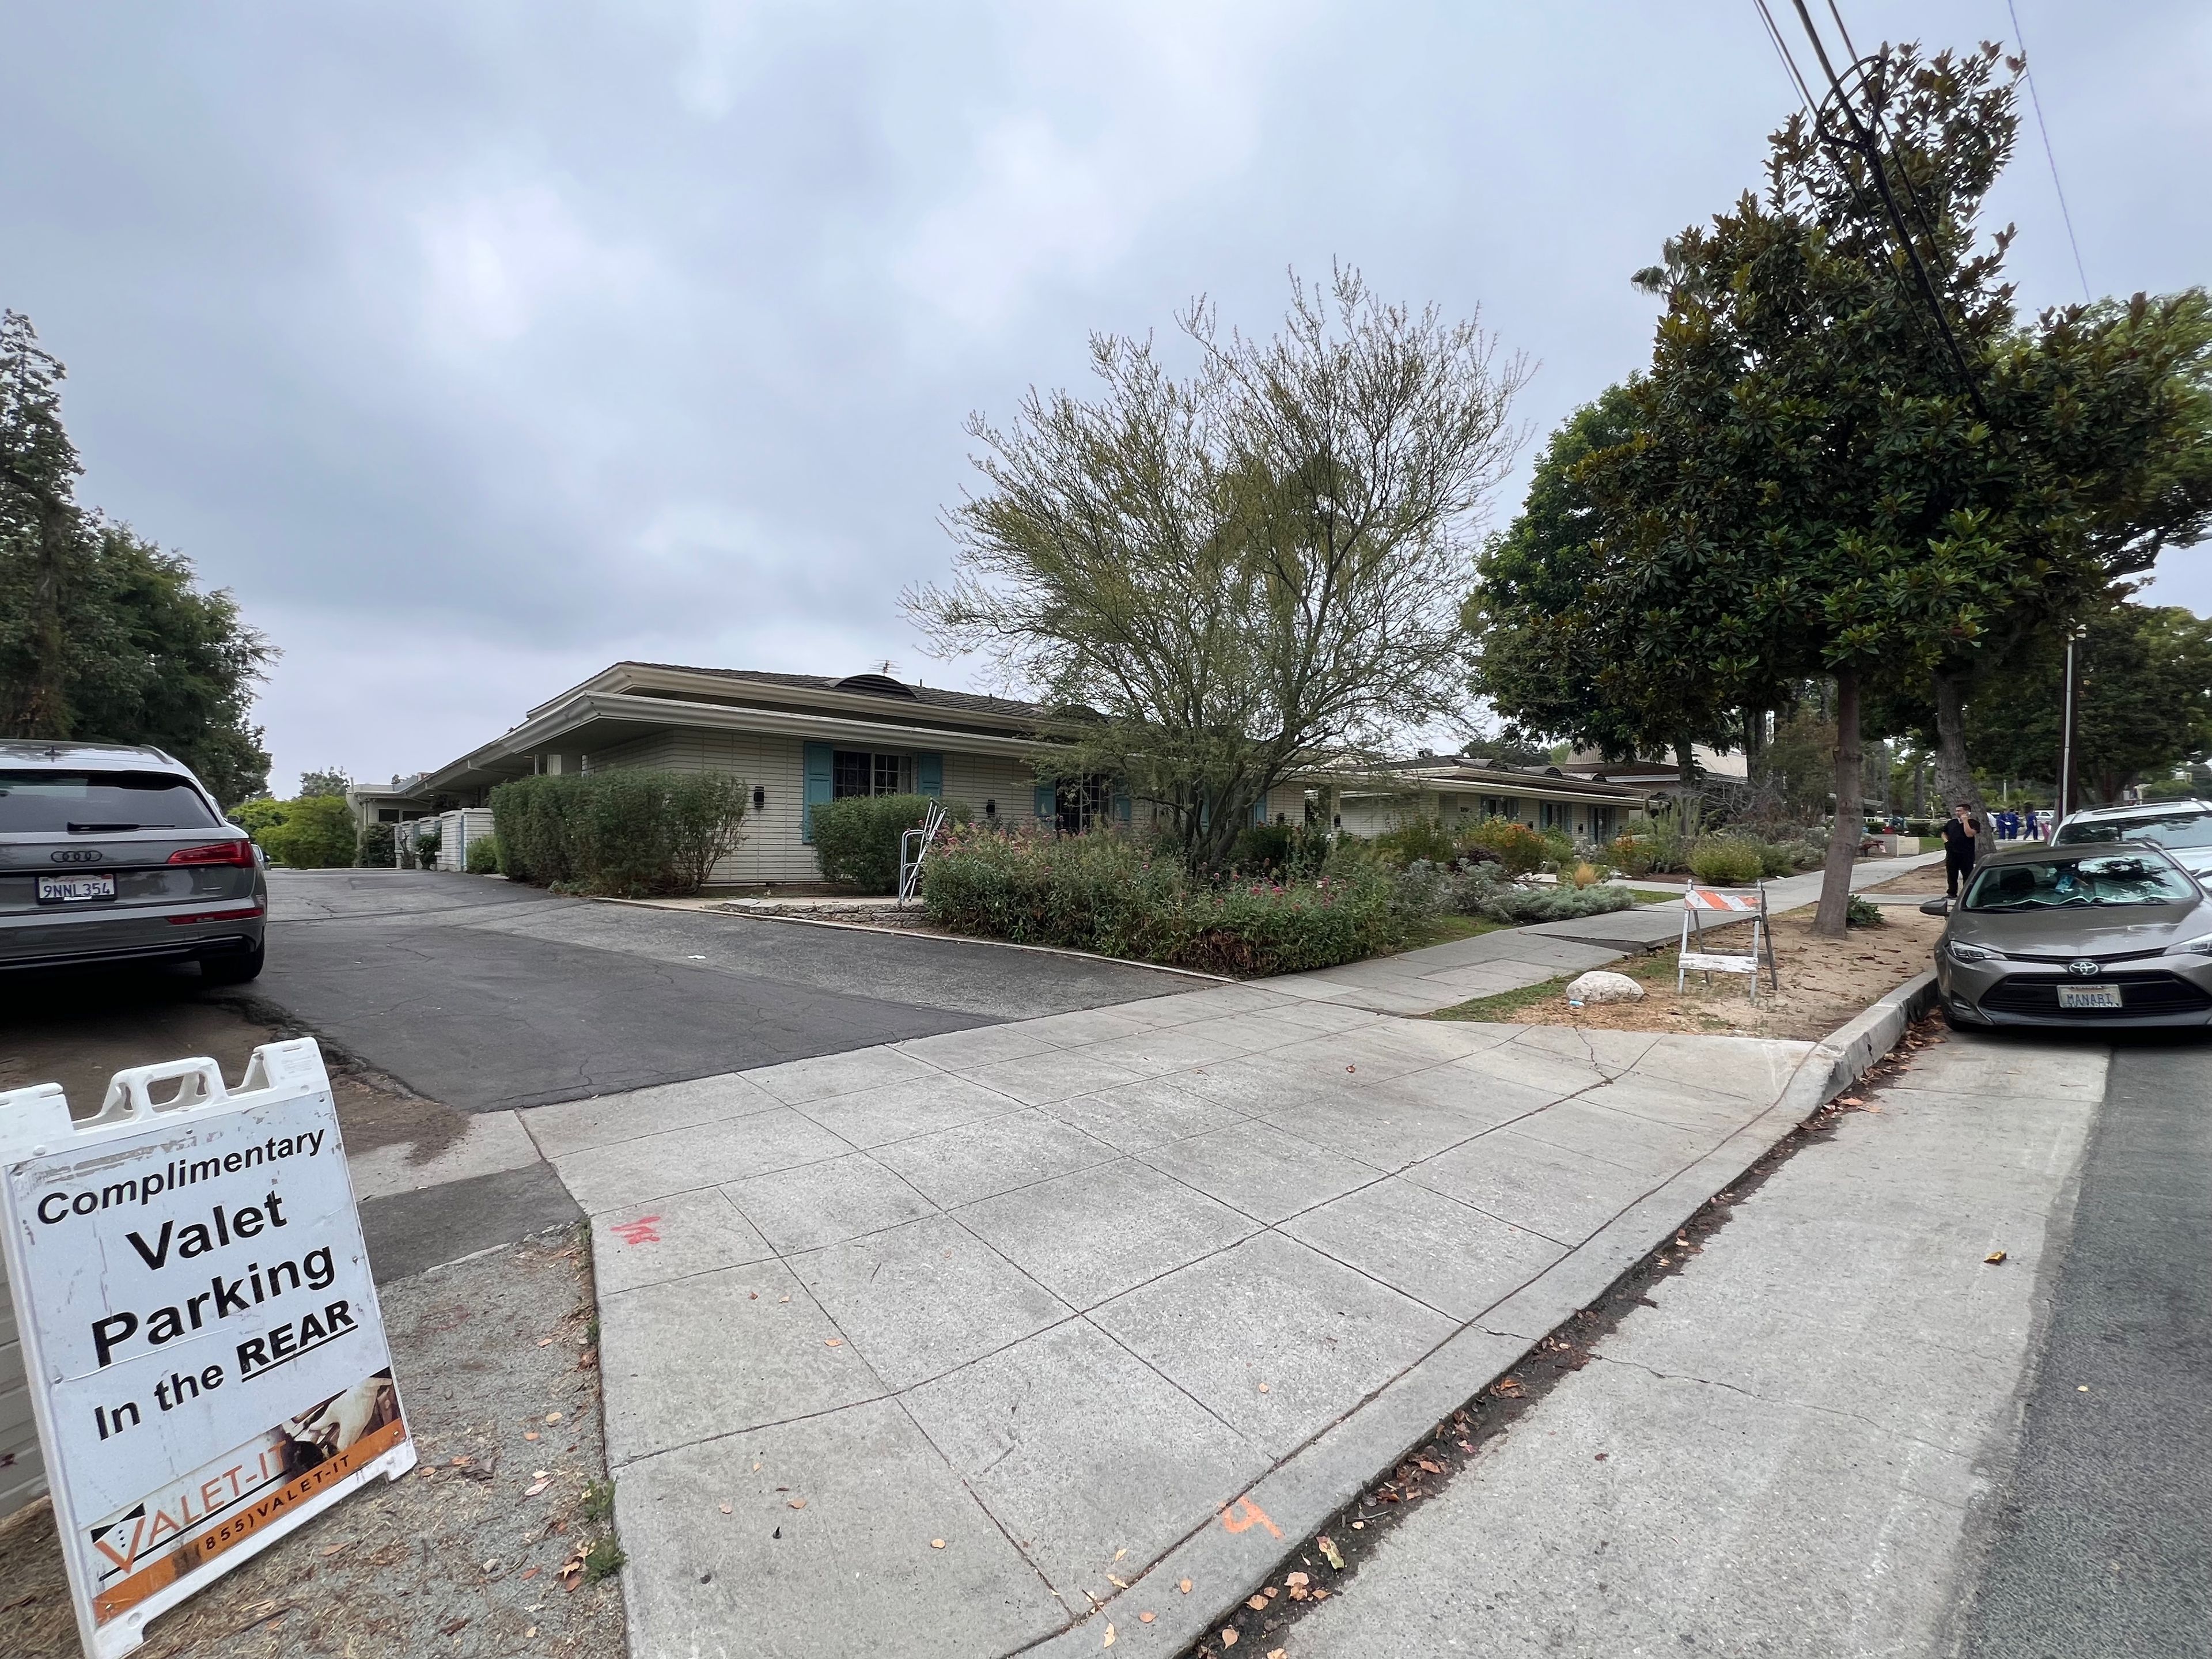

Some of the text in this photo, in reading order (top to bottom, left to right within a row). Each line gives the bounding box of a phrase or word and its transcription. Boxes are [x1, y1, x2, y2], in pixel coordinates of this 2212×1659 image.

[44, 882, 110, 897] 9NNL354
[37, 1129, 324, 1224] Complimentary
[126, 1190, 287, 1271] Valet
[92, 1246, 335, 1368] Parking
[94, 1300, 354, 1441] In the REAR
[94, 1440, 286, 1574] VALET-IT
